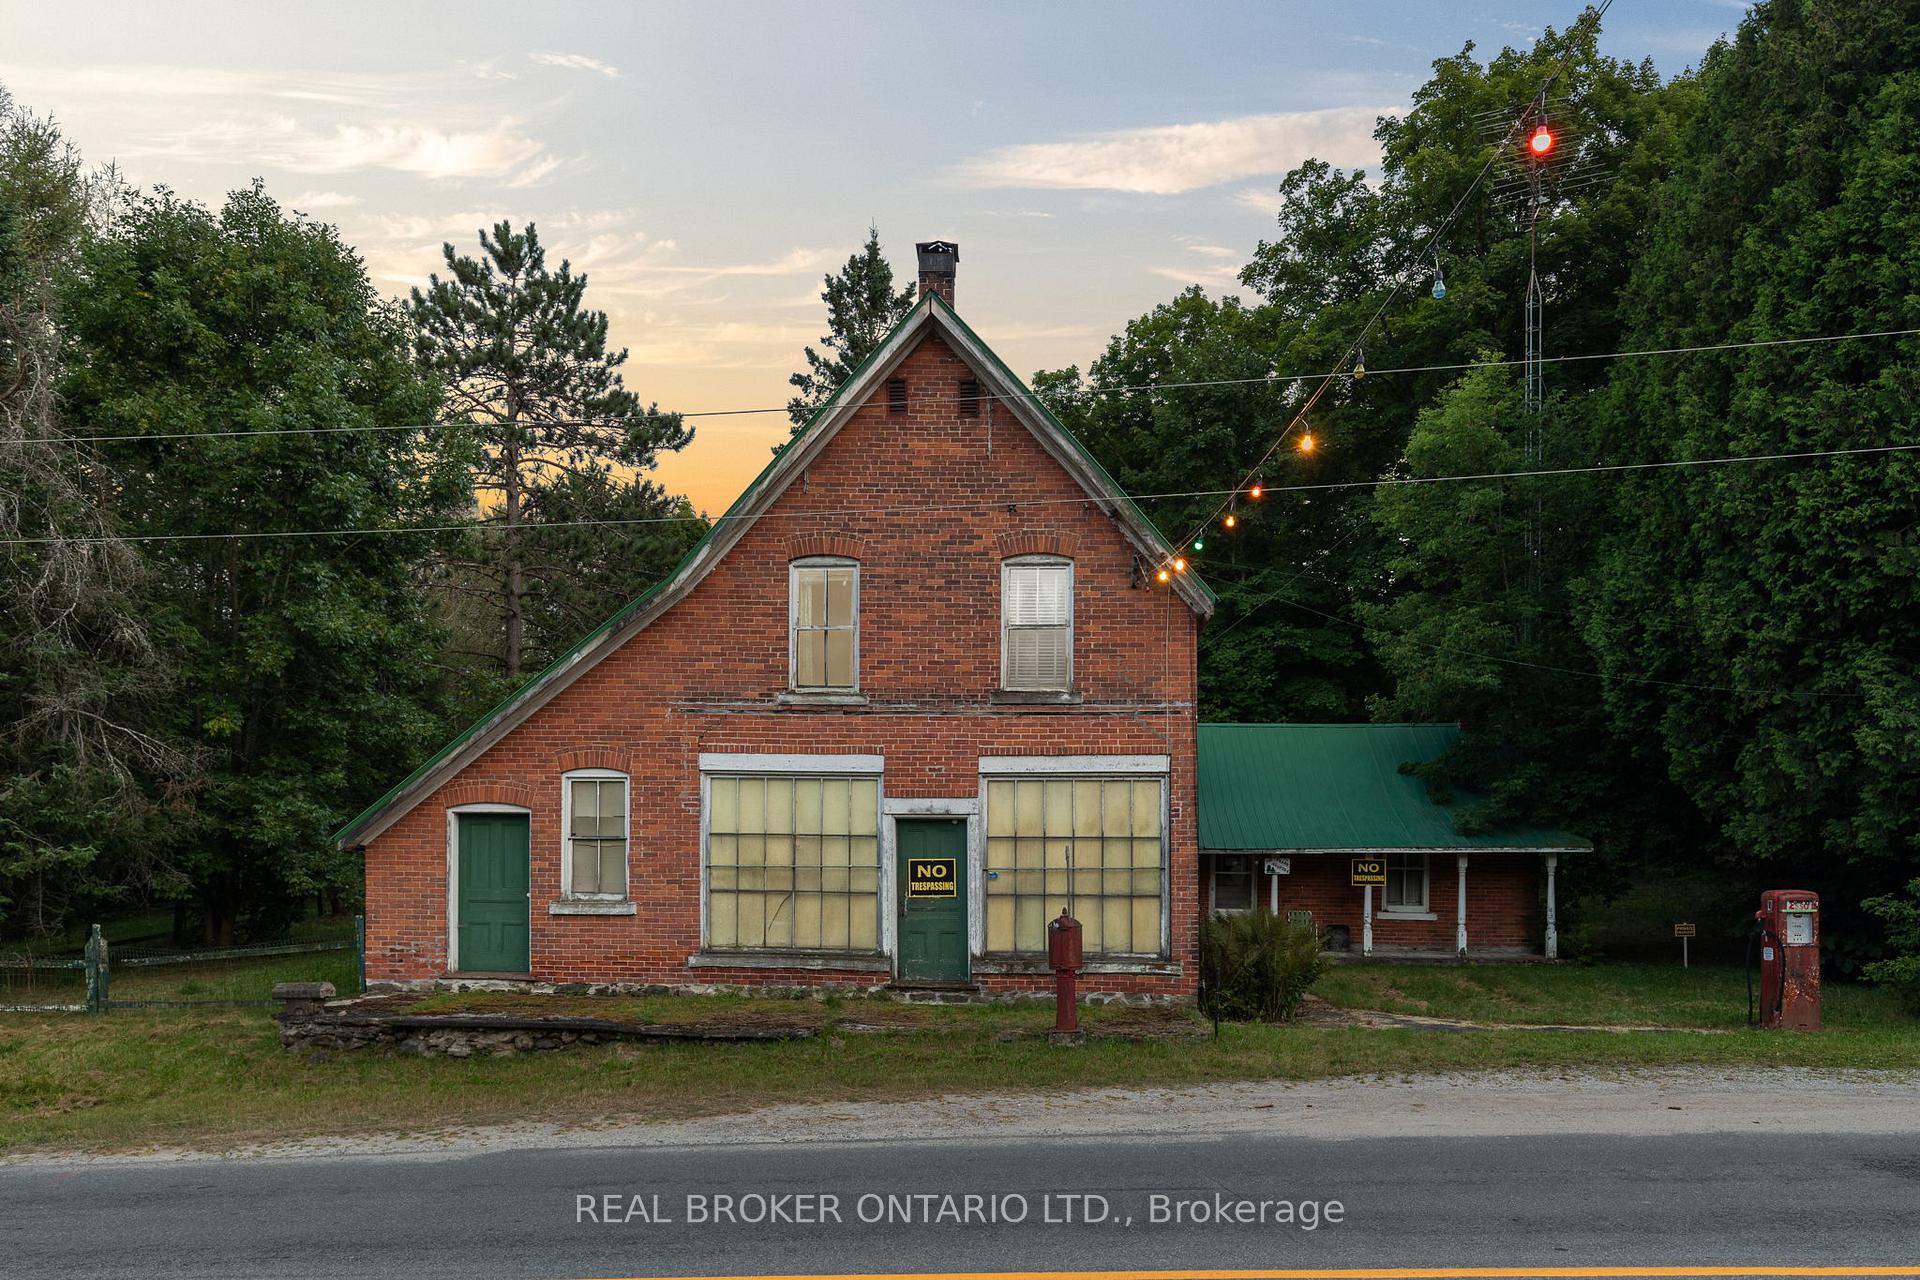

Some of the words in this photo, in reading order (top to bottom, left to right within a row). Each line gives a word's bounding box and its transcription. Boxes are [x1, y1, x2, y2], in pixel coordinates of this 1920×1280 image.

[917, 864, 947, 878] NO
[1358, 863, 1380, 873] NO
[911, 881, 954, 891] TRESPASSING
